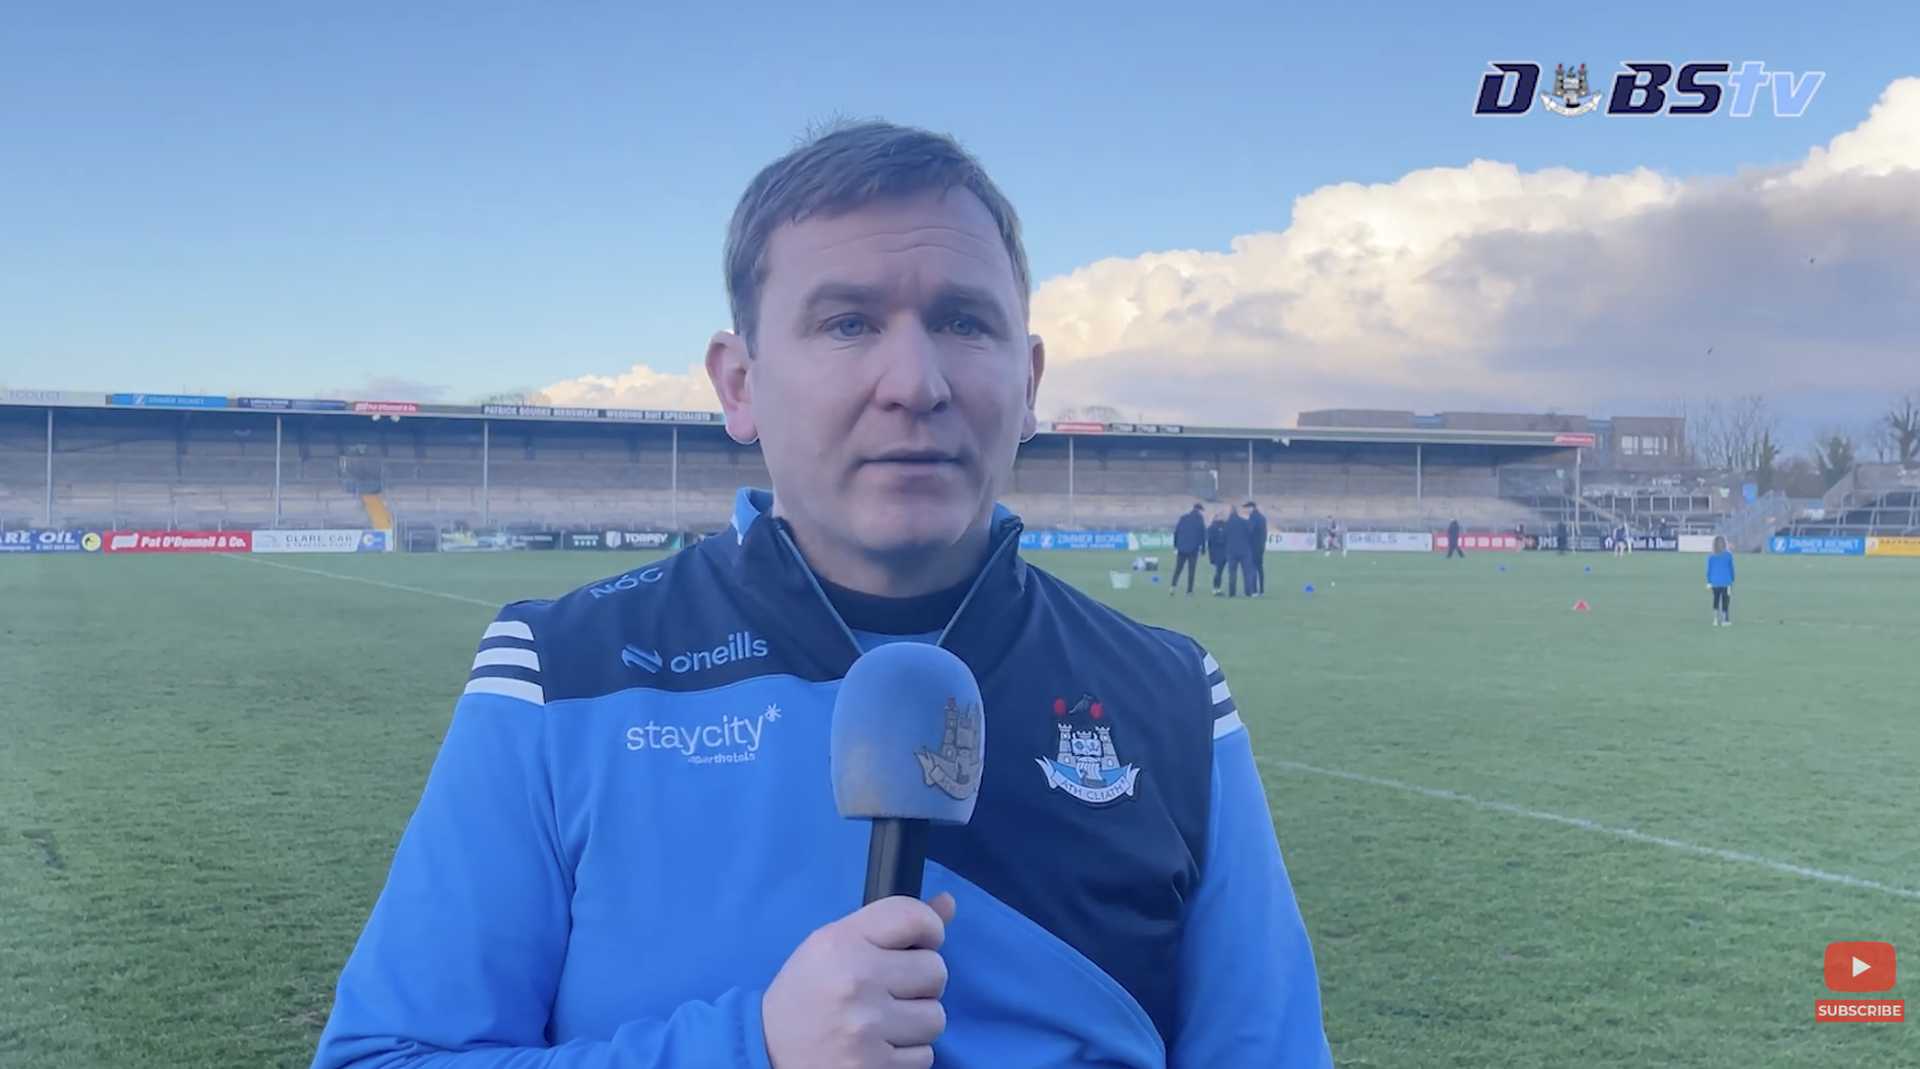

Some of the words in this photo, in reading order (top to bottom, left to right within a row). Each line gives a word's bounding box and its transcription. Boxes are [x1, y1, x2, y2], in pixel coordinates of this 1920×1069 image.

[484, 405, 518, 416] PATRICK
[553, 407, 599, 418] MENSWEAR
[606, 409, 643, 420] WEDDING
[663, 411, 712, 422] SPECIALISTS
[0, 531, 31, 544] RE
[39, 531, 76, 544] OIL
[141, 535, 161, 548] Pat
[162, 535, 216, 548] O'Donnell
[217, 536, 227, 548] &
[285, 534, 321, 542] CLARE
[329, 534, 352, 542] CAR
[624, 533, 669, 544] TORPEY
[590, 567, 664, 599] NÓC
